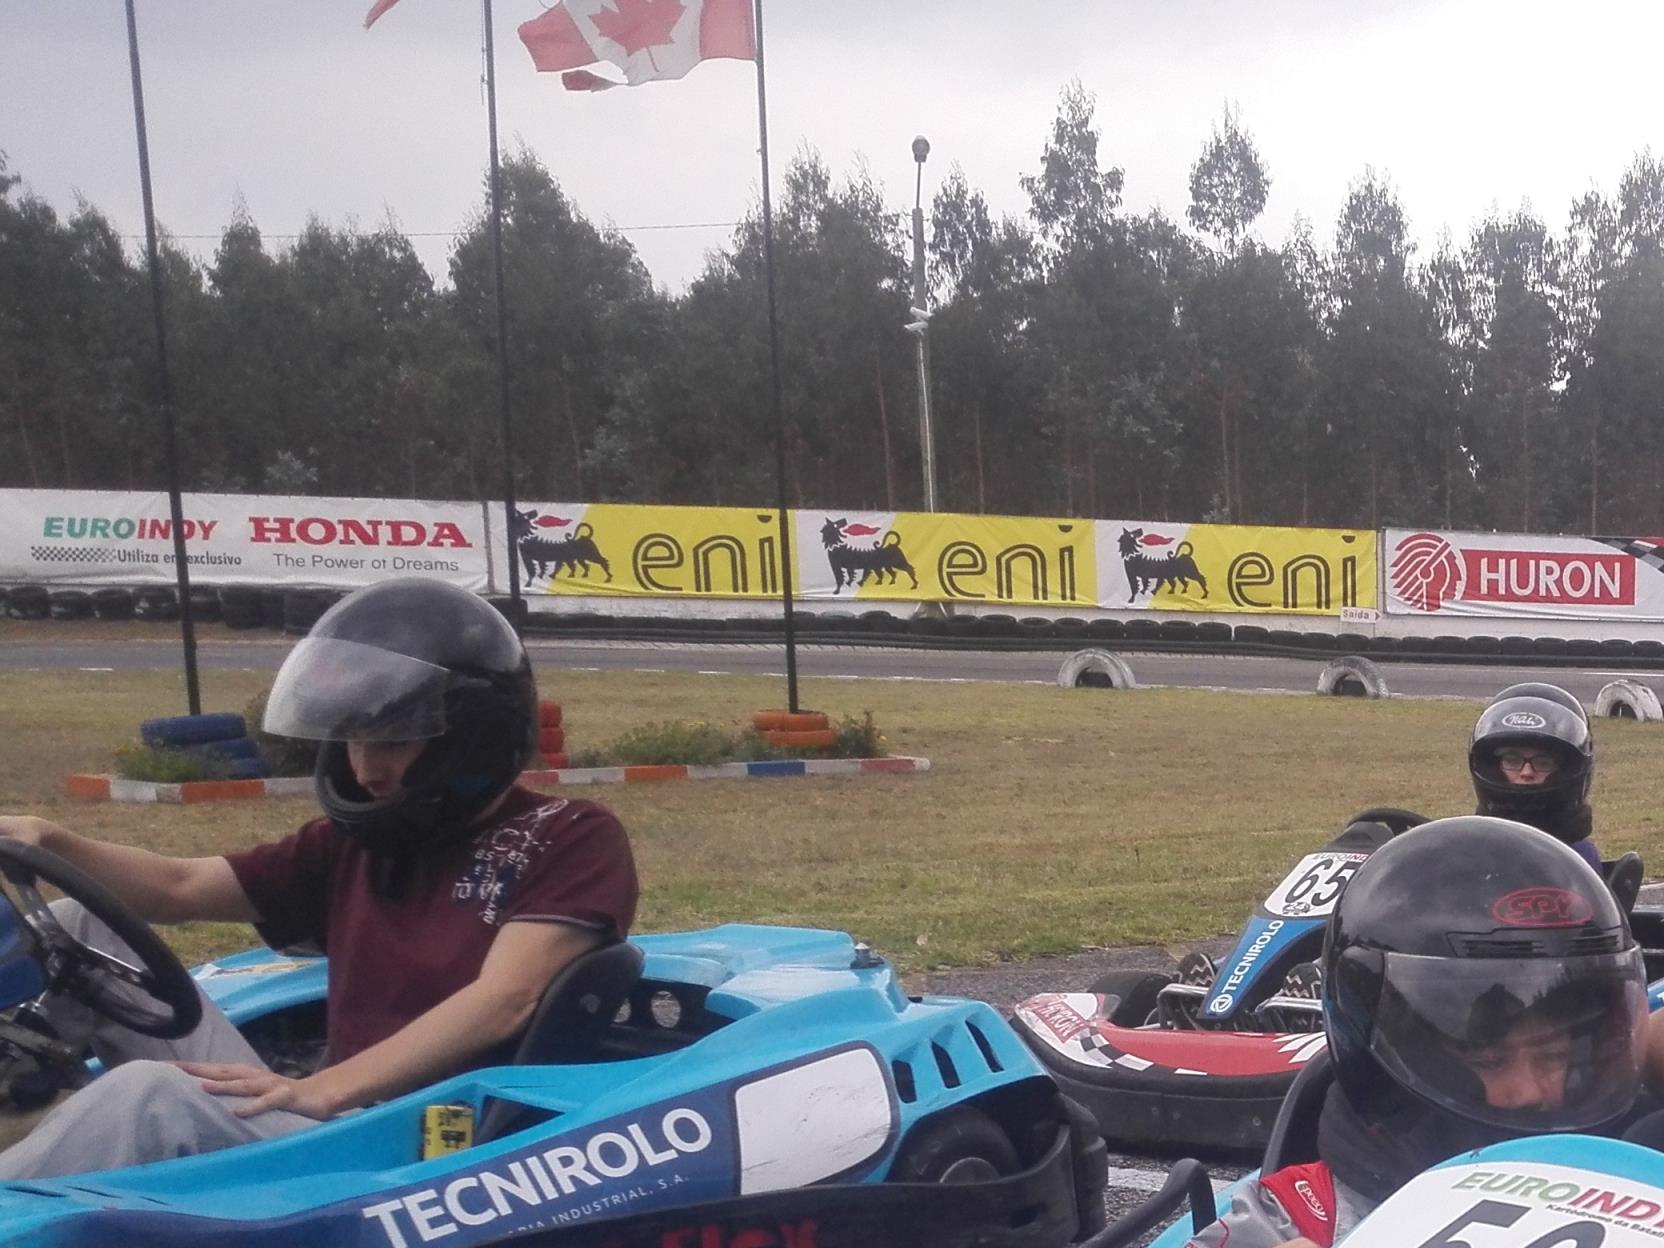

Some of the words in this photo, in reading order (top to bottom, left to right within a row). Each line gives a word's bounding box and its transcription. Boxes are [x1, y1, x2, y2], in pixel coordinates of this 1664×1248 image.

[43, 516, 218, 541] EUROINDY
[248, 516, 473, 549] HONDA
[631, 514, 778, 594] eni
[117, 548, 159, 564] Utiliza
[187, 551, 242, 566] exclusivo
[273, 553, 306, 568] The
[312, 554, 366, 569] Power
[371, 557, 387, 570] of
[393, 556, 459, 572] Dreams
[937, 524, 1076, 601] eni
[1227, 535, 1357, 609] eni
[1479, 555, 1621, 600] HURON
[1284, 858, 1361, 907] 65
[1221, 920, 1285, 994] TECNIROLO
[1614, 1219, 1629, 1228] da
